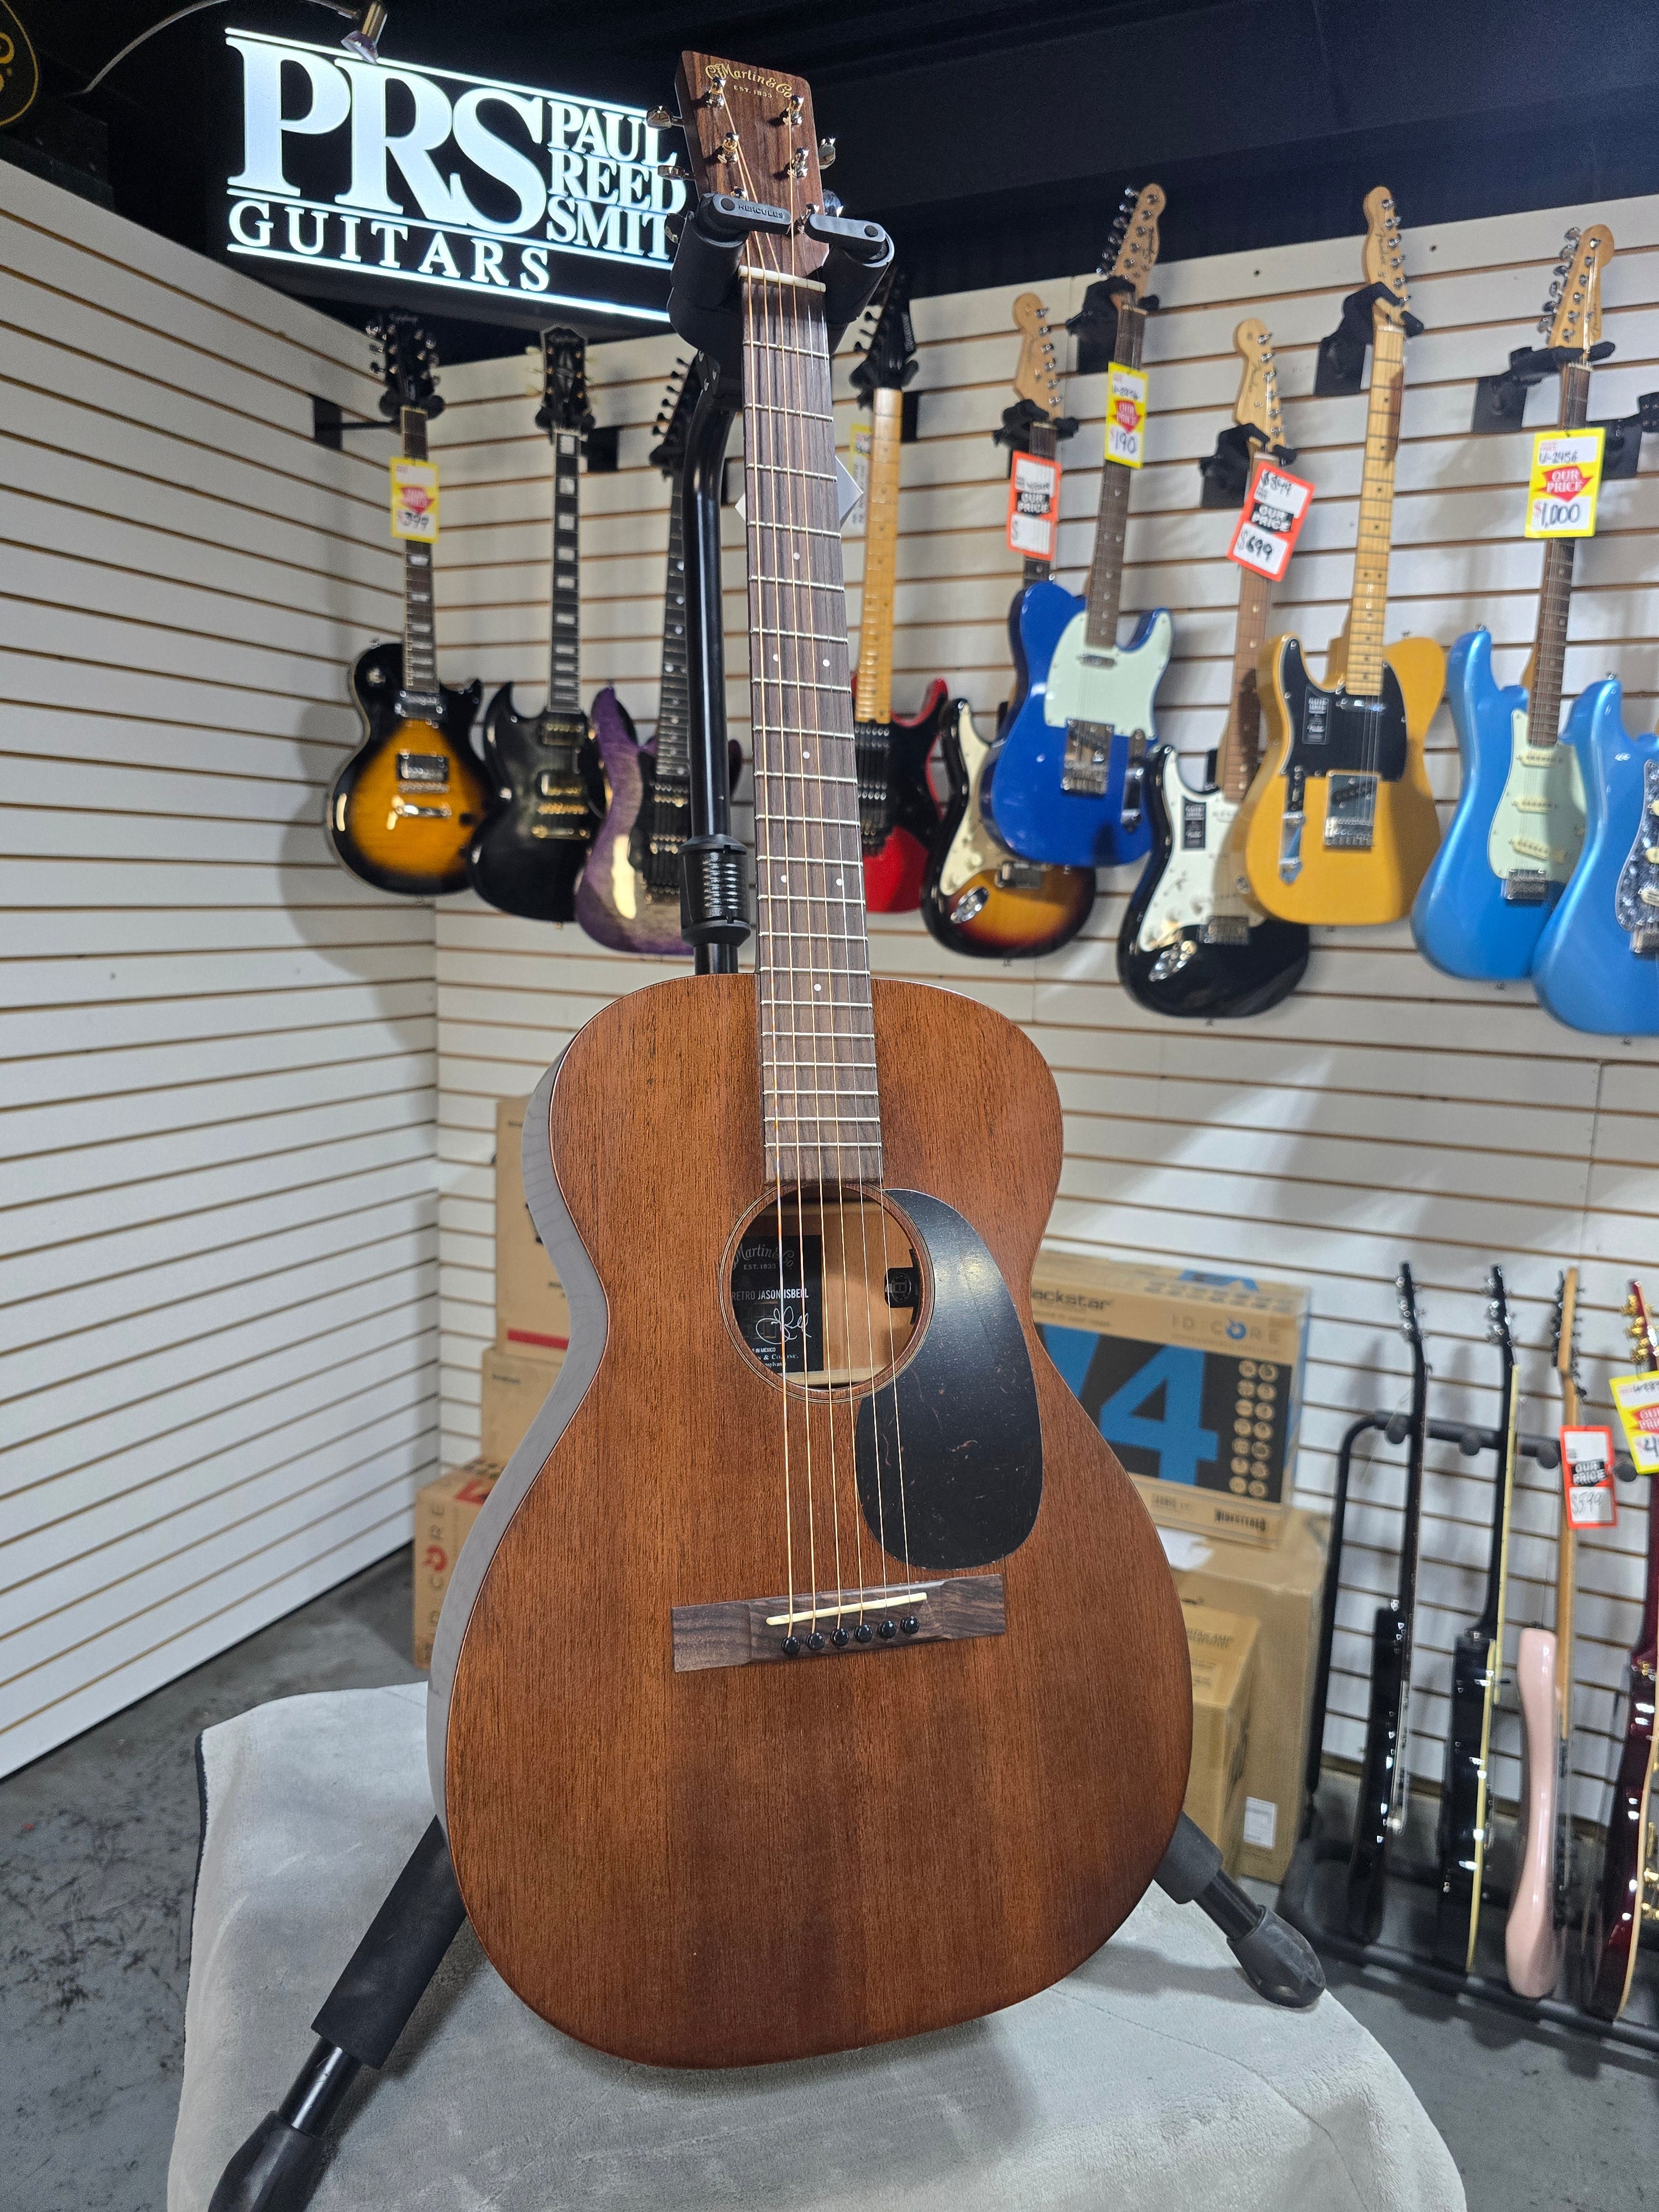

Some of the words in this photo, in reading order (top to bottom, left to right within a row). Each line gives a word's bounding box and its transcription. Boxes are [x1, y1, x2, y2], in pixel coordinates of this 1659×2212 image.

[225, 36, 546, 235] PRS
[547, 100, 678, 167] PAUL
[547, 148, 687, 215] REED
[738, 203, 784, 219] HERCULES
[546, 195, 670, 260] SMIT
[228, 200, 550, 292] GUITARS
[1551, 468, 1580, 482] OUR
[1546, 479, 1584, 493] PRICE
[1017, 500, 1050, 513] PRICE
[1021, 492, 1047, 504] OUR
[1259, 503, 1289, 521] OUR
[1251, 510, 1292, 533] PRICE
[1237, 528, 1272, 562] $699
[732, 1290, 755, 1301] RETRO
[758, 1289, 781, 1300] JASON
[1031, 1288, 1108, 1311] ackstar
[1640, 1410, 1659, 1420] OU
[1572, 1468, 1607, 1485] PRICE
[1575, 1462, 1600, 1474] OUR
